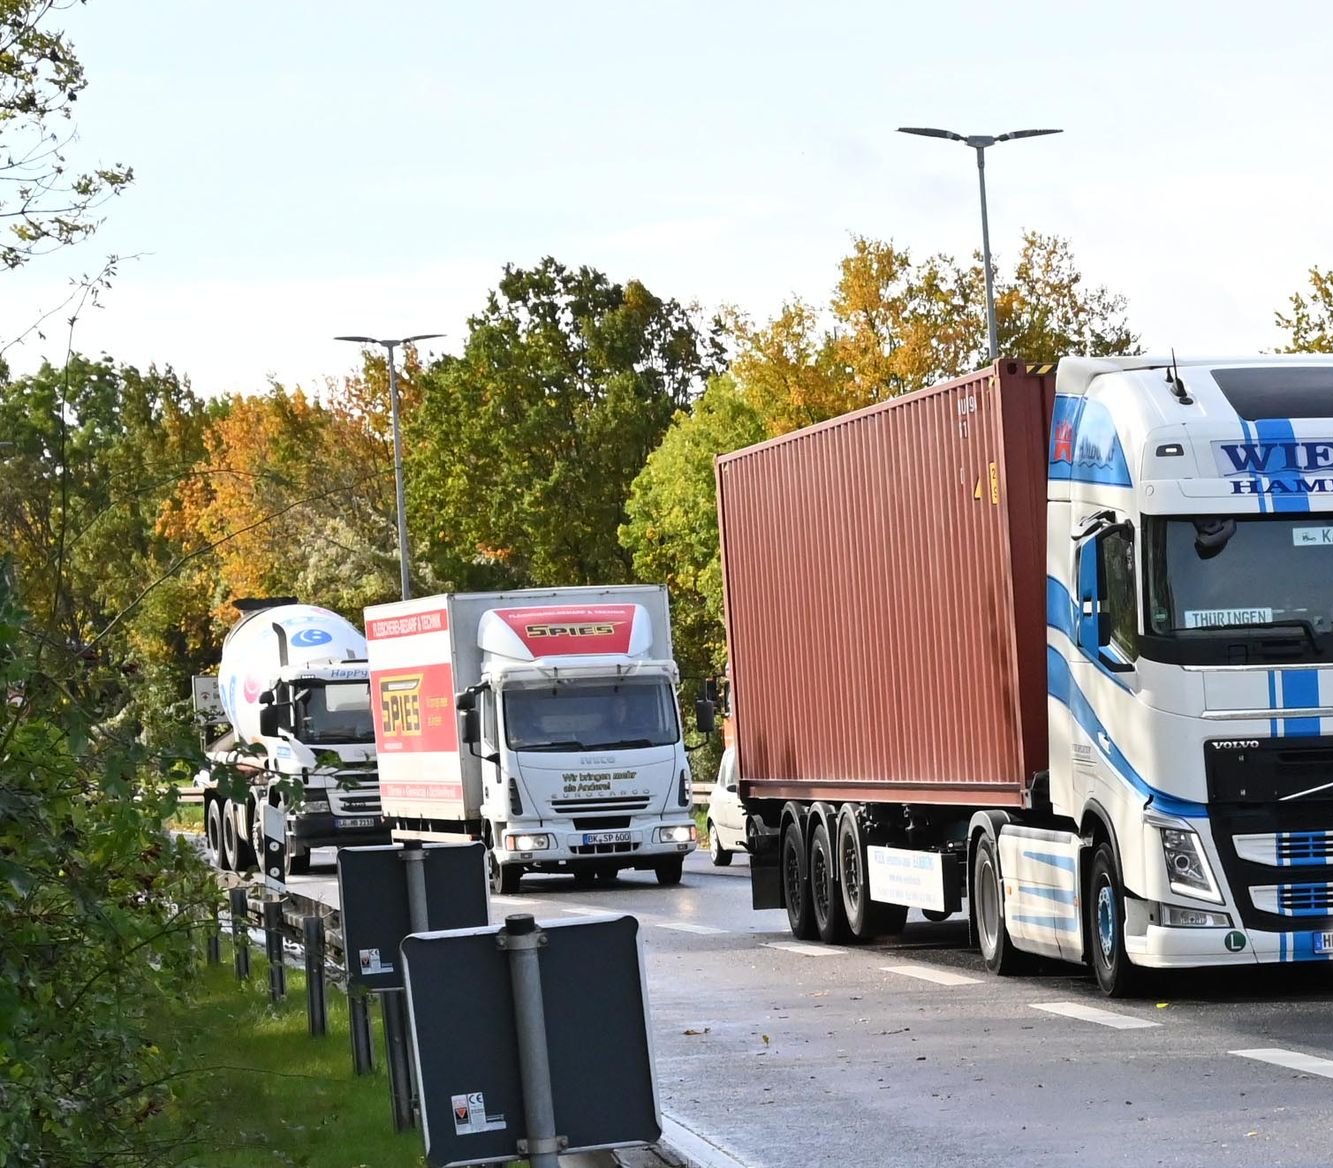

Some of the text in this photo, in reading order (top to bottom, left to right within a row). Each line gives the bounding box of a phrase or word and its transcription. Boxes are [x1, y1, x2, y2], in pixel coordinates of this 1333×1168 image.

[525, 623, 618, 638] SPIES
[379, 674, 424, 737] SPIES
[1212, 740, 1260, 750] VOLVO
[604, 833, 614, 842] SP
[615, 832, 630, 842] 600
